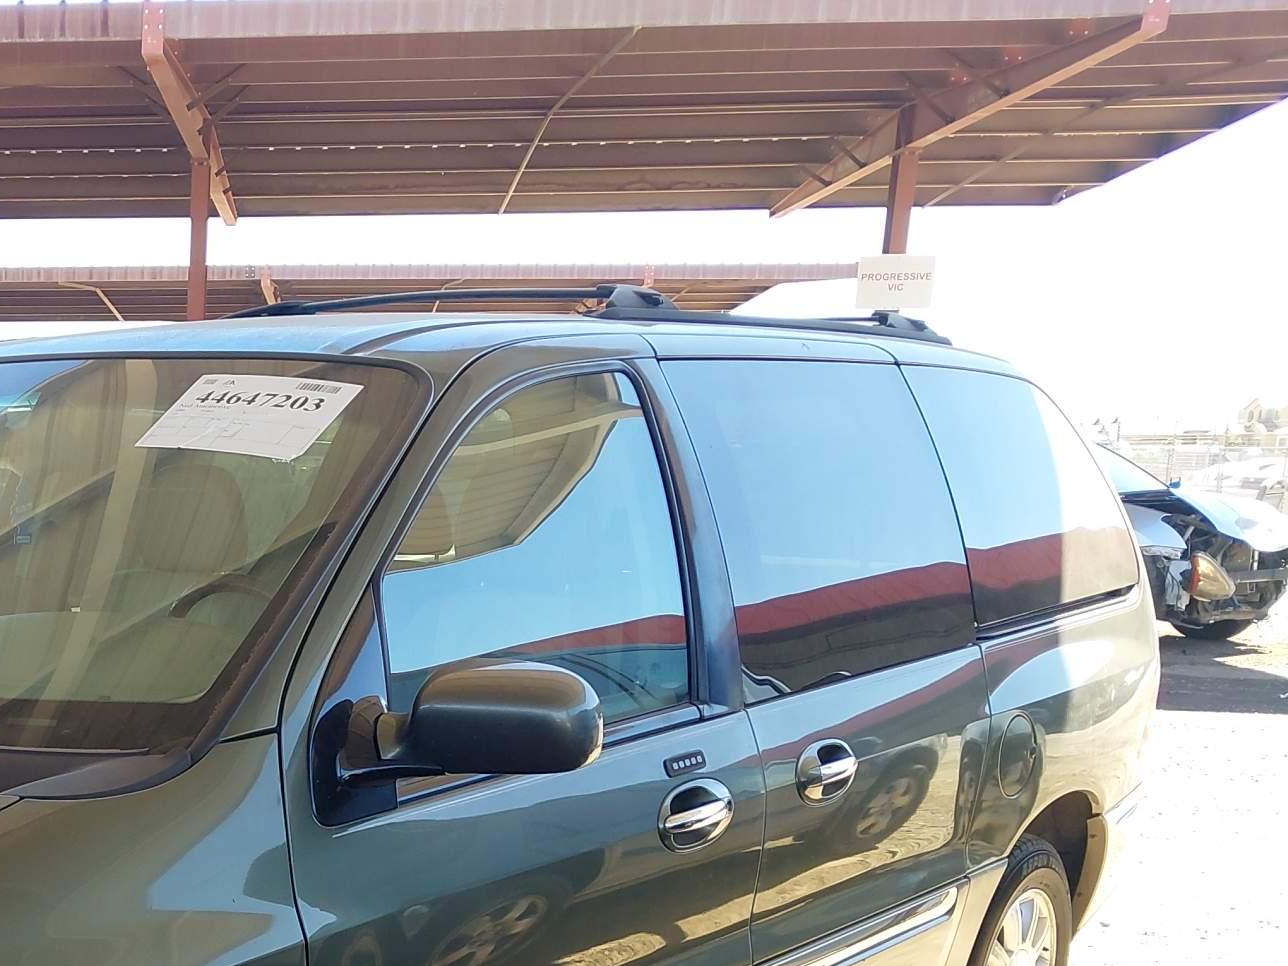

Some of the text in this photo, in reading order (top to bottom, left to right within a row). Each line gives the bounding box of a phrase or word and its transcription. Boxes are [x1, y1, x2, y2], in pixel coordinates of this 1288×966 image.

[861, 272, 932, 281] PROGRESSIVE
[887, 283, 904, 291] VIC
[195, 390, 326, 412] 44647203
